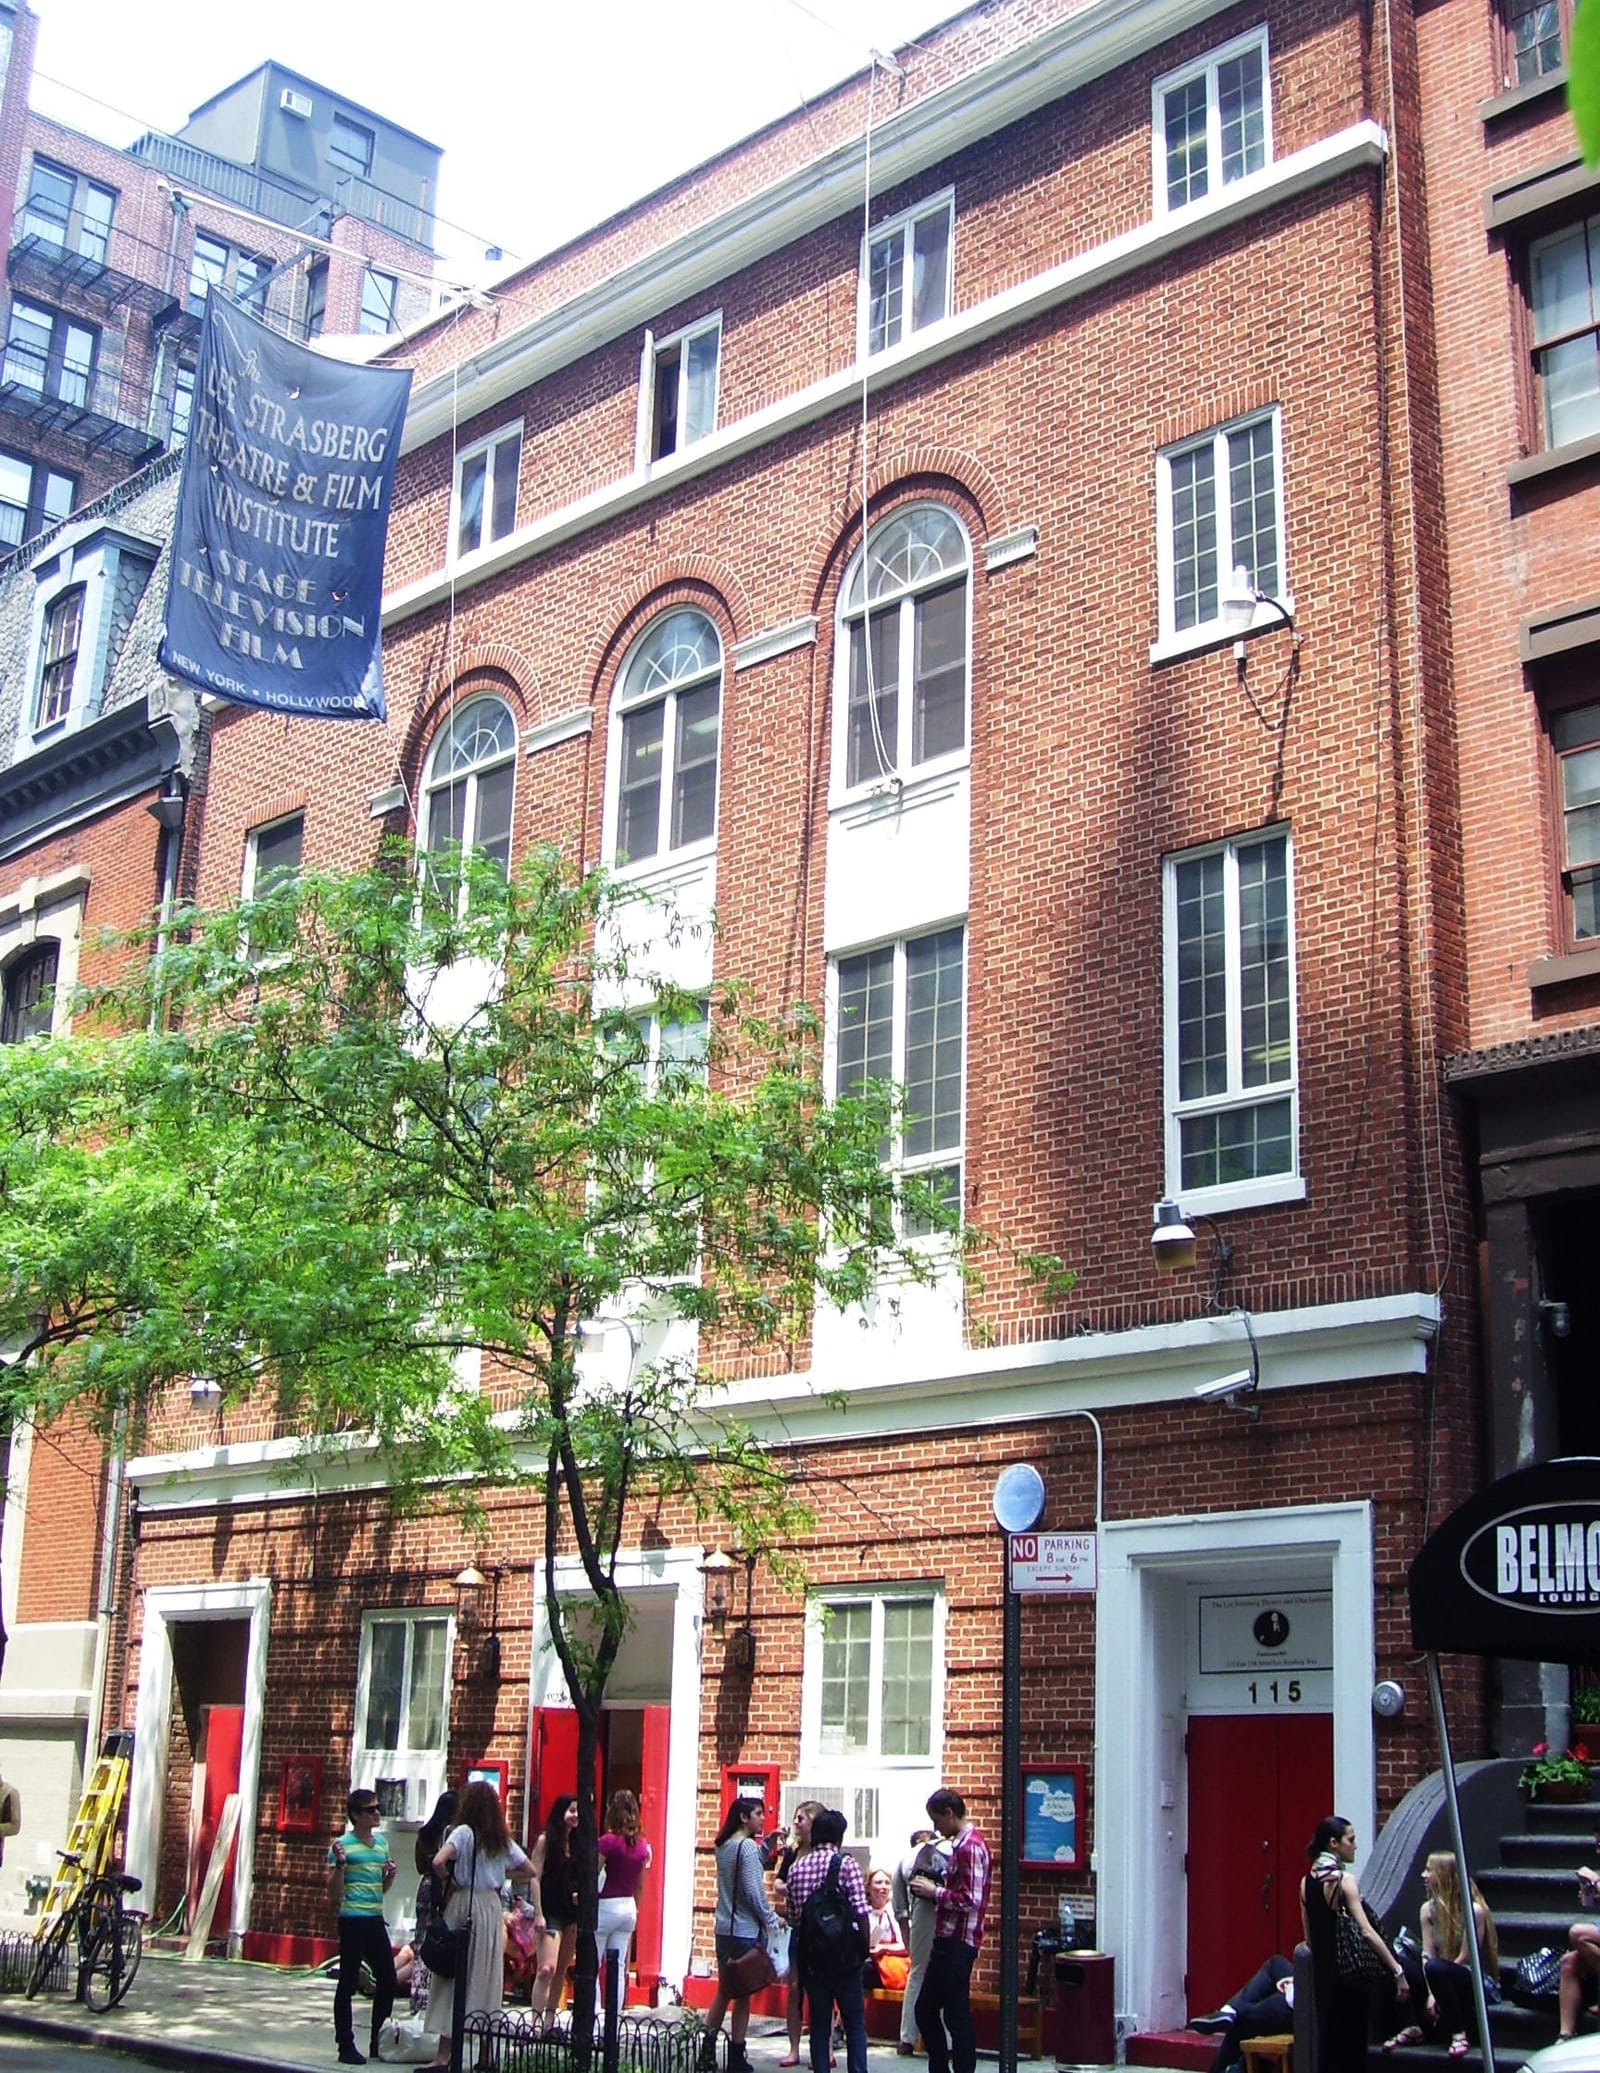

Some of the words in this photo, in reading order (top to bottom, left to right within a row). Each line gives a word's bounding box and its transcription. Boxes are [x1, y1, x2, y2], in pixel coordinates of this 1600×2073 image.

[207, 357, 238, 415] LEE
[245, 393, 388, 463] STRASBERG
[195, 407, 290, 496] THEATRE
[292, 472, 318, 505] &
[322, 472, 384, 511] FILM
[215, 482, 341, 559] INSTITUTE
[179, 557, 366, 639] TELEVISION
[218, 549, 318, 606] STAGE
[172, 651, 201, 676] NEW
[206, 670, 248, 695] YORK
[218, 622, 305, 669] FILM
[1012, 1538, 1036, 1559] NO
[1044, 1539, 1090, 1551] PARKING
[1497, 1520, 1600, 1594] BELMO
[1539, 1592, 1600, 1603] LOUNG
[1248, 1681, 1301, 1704] 115
